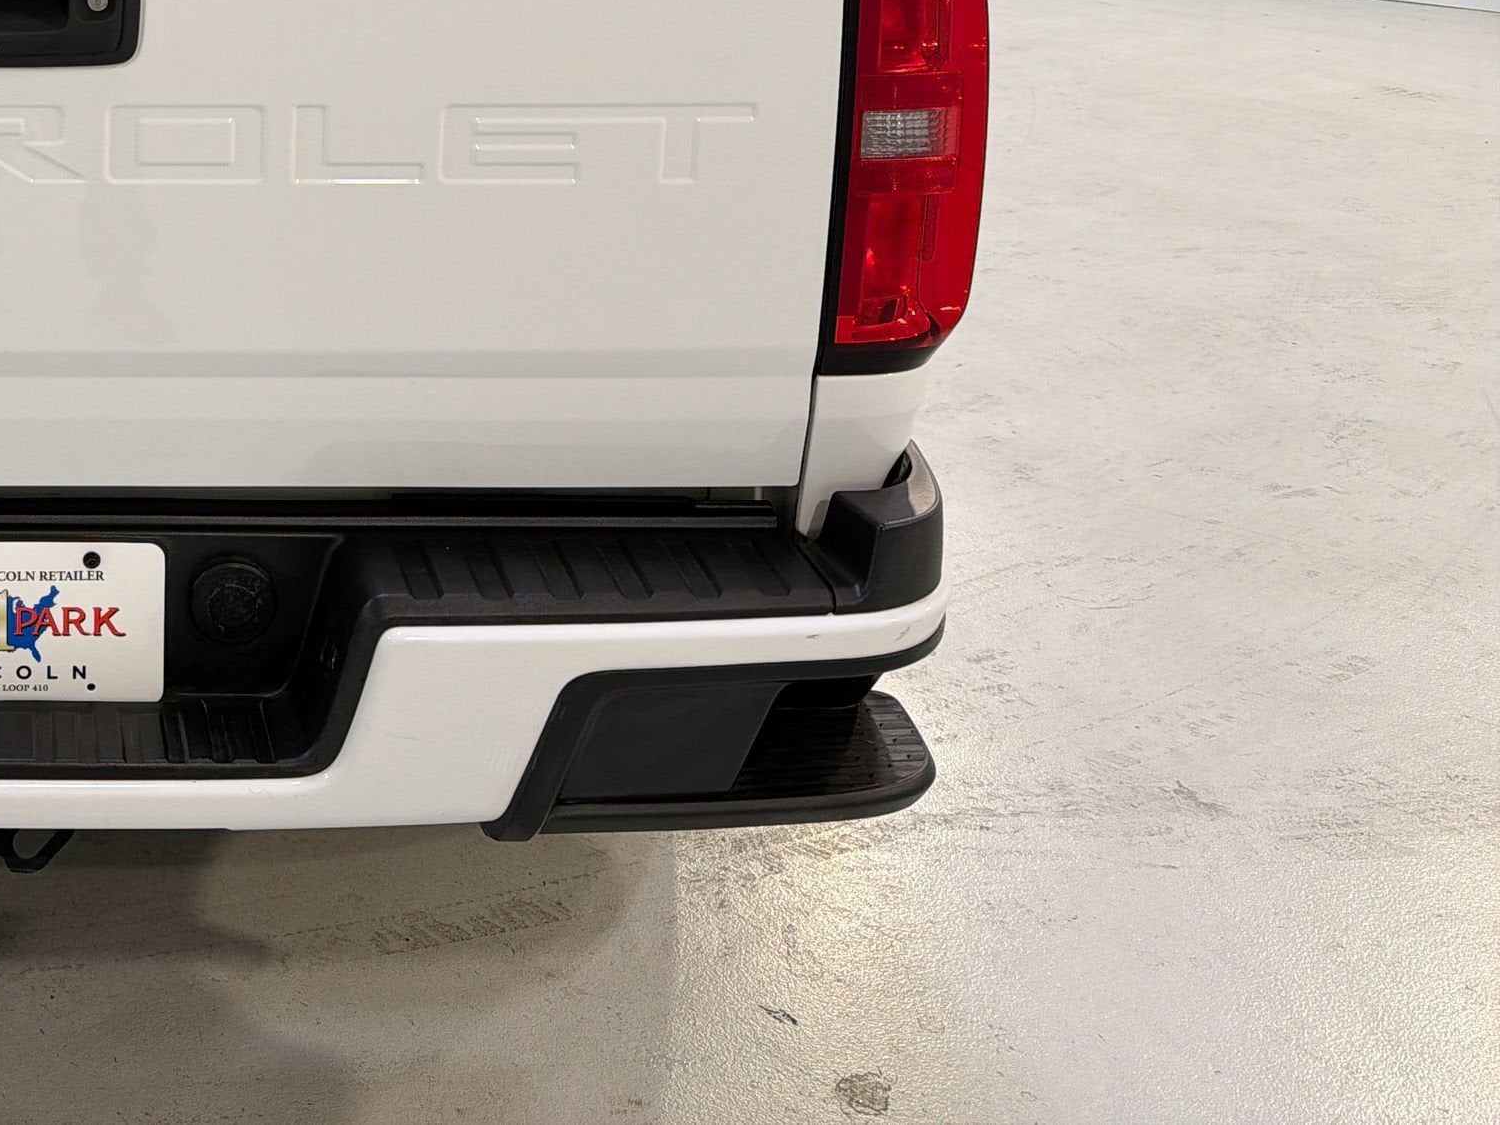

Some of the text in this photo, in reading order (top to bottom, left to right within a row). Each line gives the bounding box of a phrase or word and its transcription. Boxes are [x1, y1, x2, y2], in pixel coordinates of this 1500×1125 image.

[39, 570, 105, 582] RETAILER
[14, 606, 127, 637] PARK
[2, 683, 30, 692] LOOP
[32, 683, 49, 692] 410
